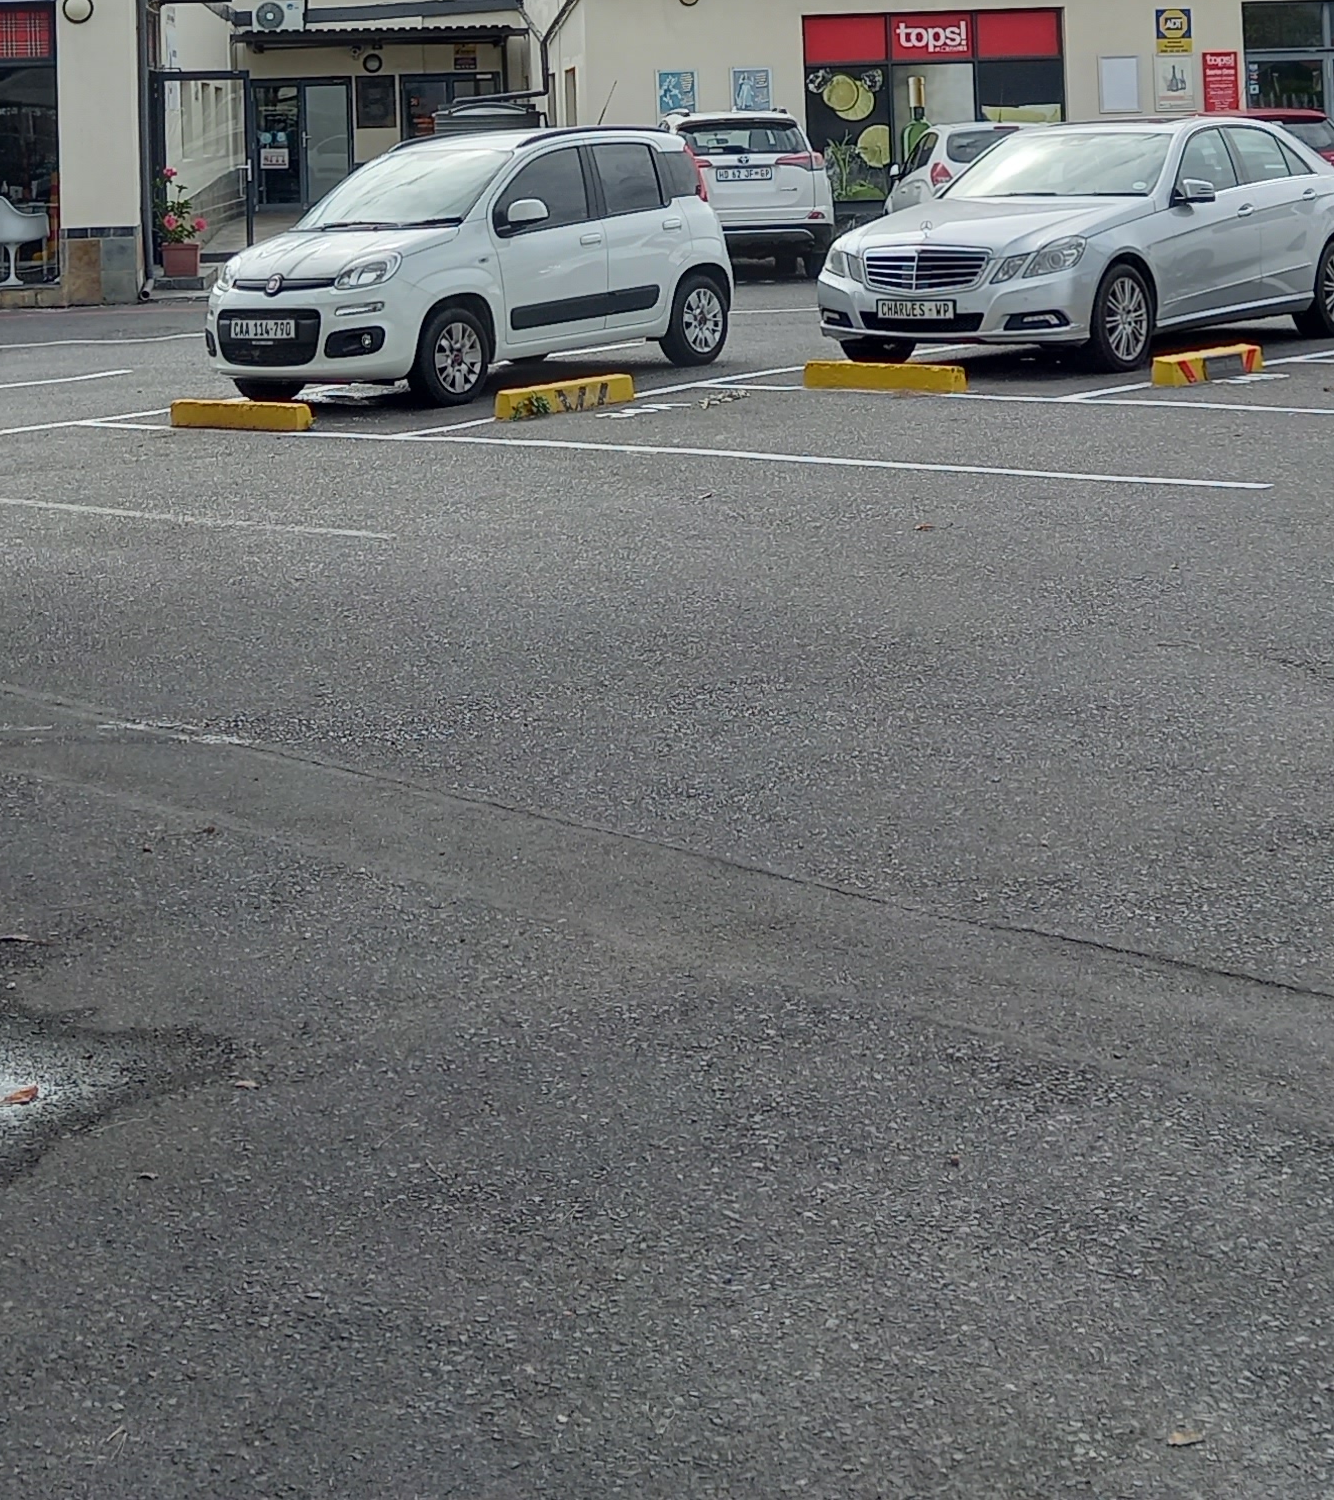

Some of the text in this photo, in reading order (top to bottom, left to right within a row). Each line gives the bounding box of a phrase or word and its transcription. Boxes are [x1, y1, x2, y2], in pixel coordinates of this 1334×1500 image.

[1164, 18, 1184, 29] ADT
[895, 20, 967, 53] tops!
[1205, 53, 1235, 67] tops!
[881, 302, 925, 317] CHARLES
[935, 302, 950, 317] WP
[233, 321, 292, 337] CAA 114-790
